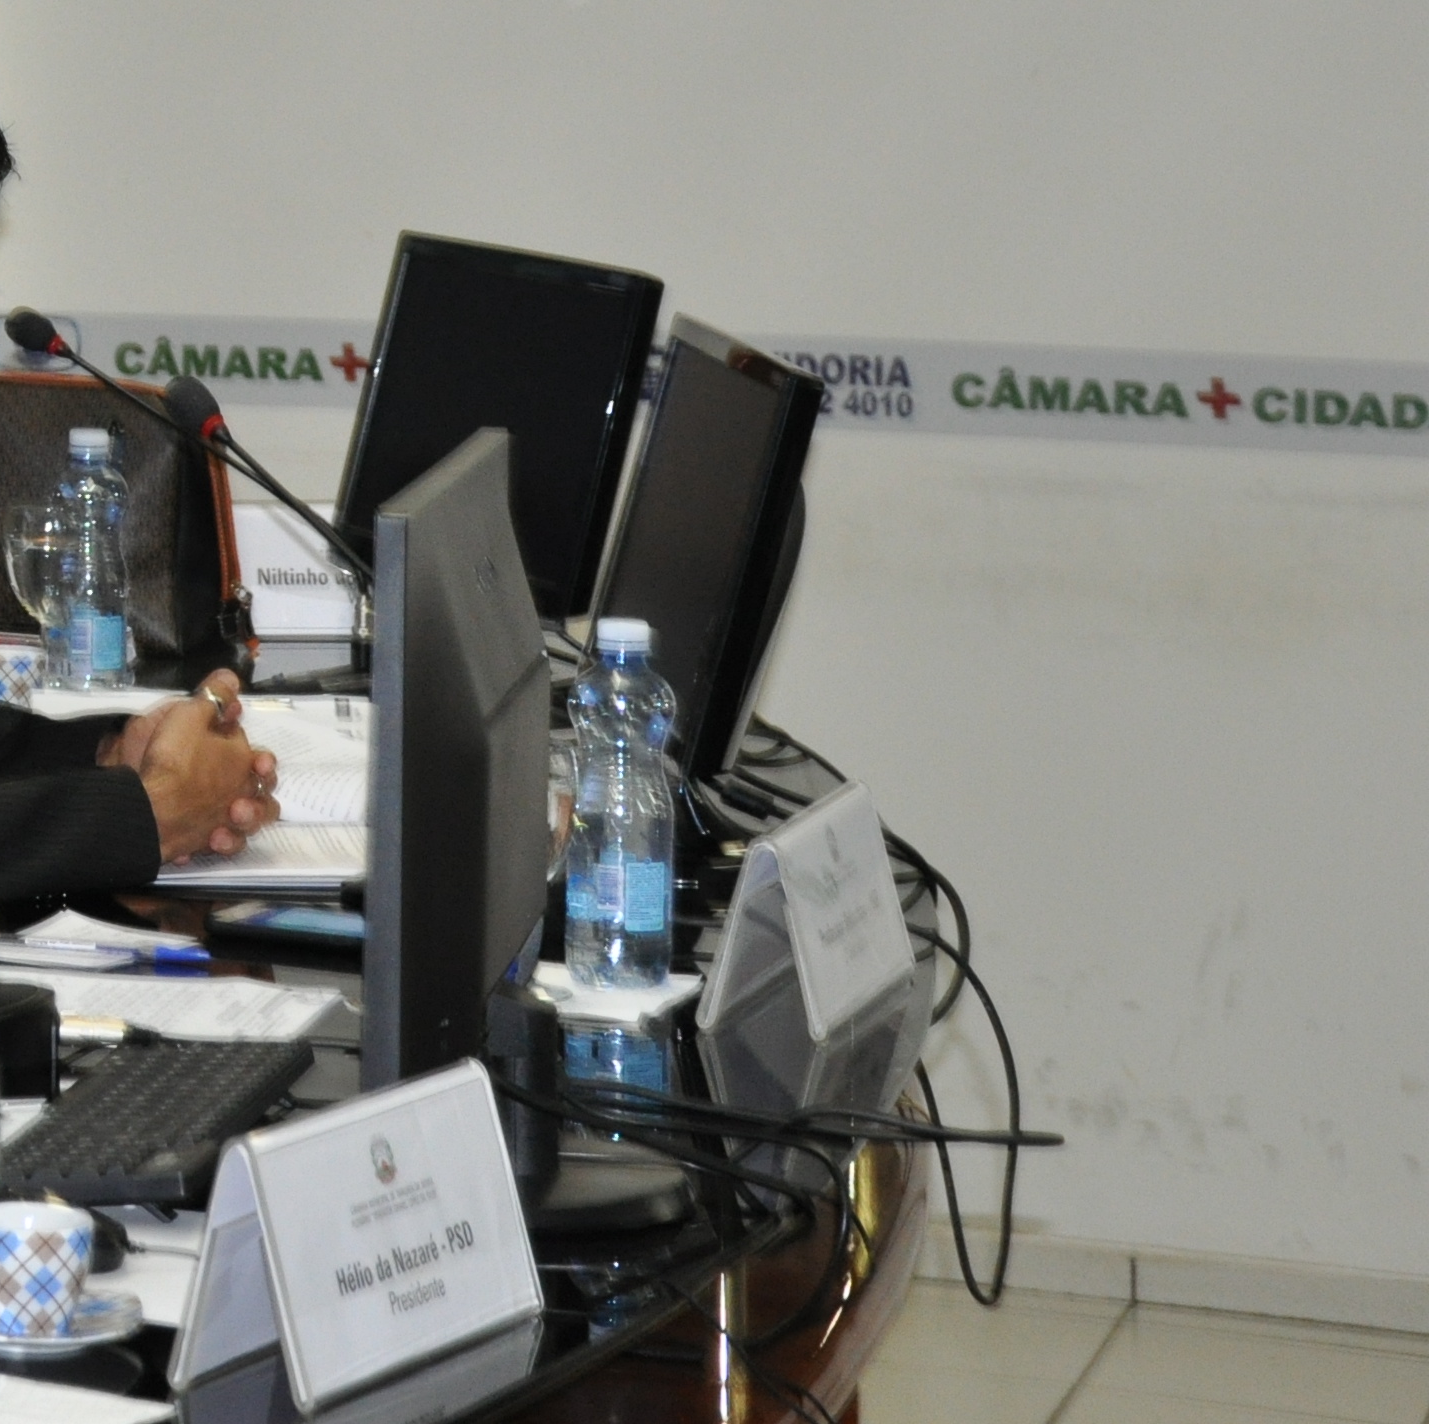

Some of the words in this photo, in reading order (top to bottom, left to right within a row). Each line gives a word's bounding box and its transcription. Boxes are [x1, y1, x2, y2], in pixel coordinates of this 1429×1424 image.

[115, 336, 323, 382] CÂMARA
[843, 392, 914, 417] 4010
[951, 366, 1189, 419] CÂMARA
[257, 568, 329, 586] Niltinho
[336, 1262, 373, 1295] Hélio
[376, 1255, 391, 1282] da
[392, 1234, 439, 1274] Nazaré
[446, 1221, 474, 1253] PSD
[389, 1278, 446, 1315] Presidente
